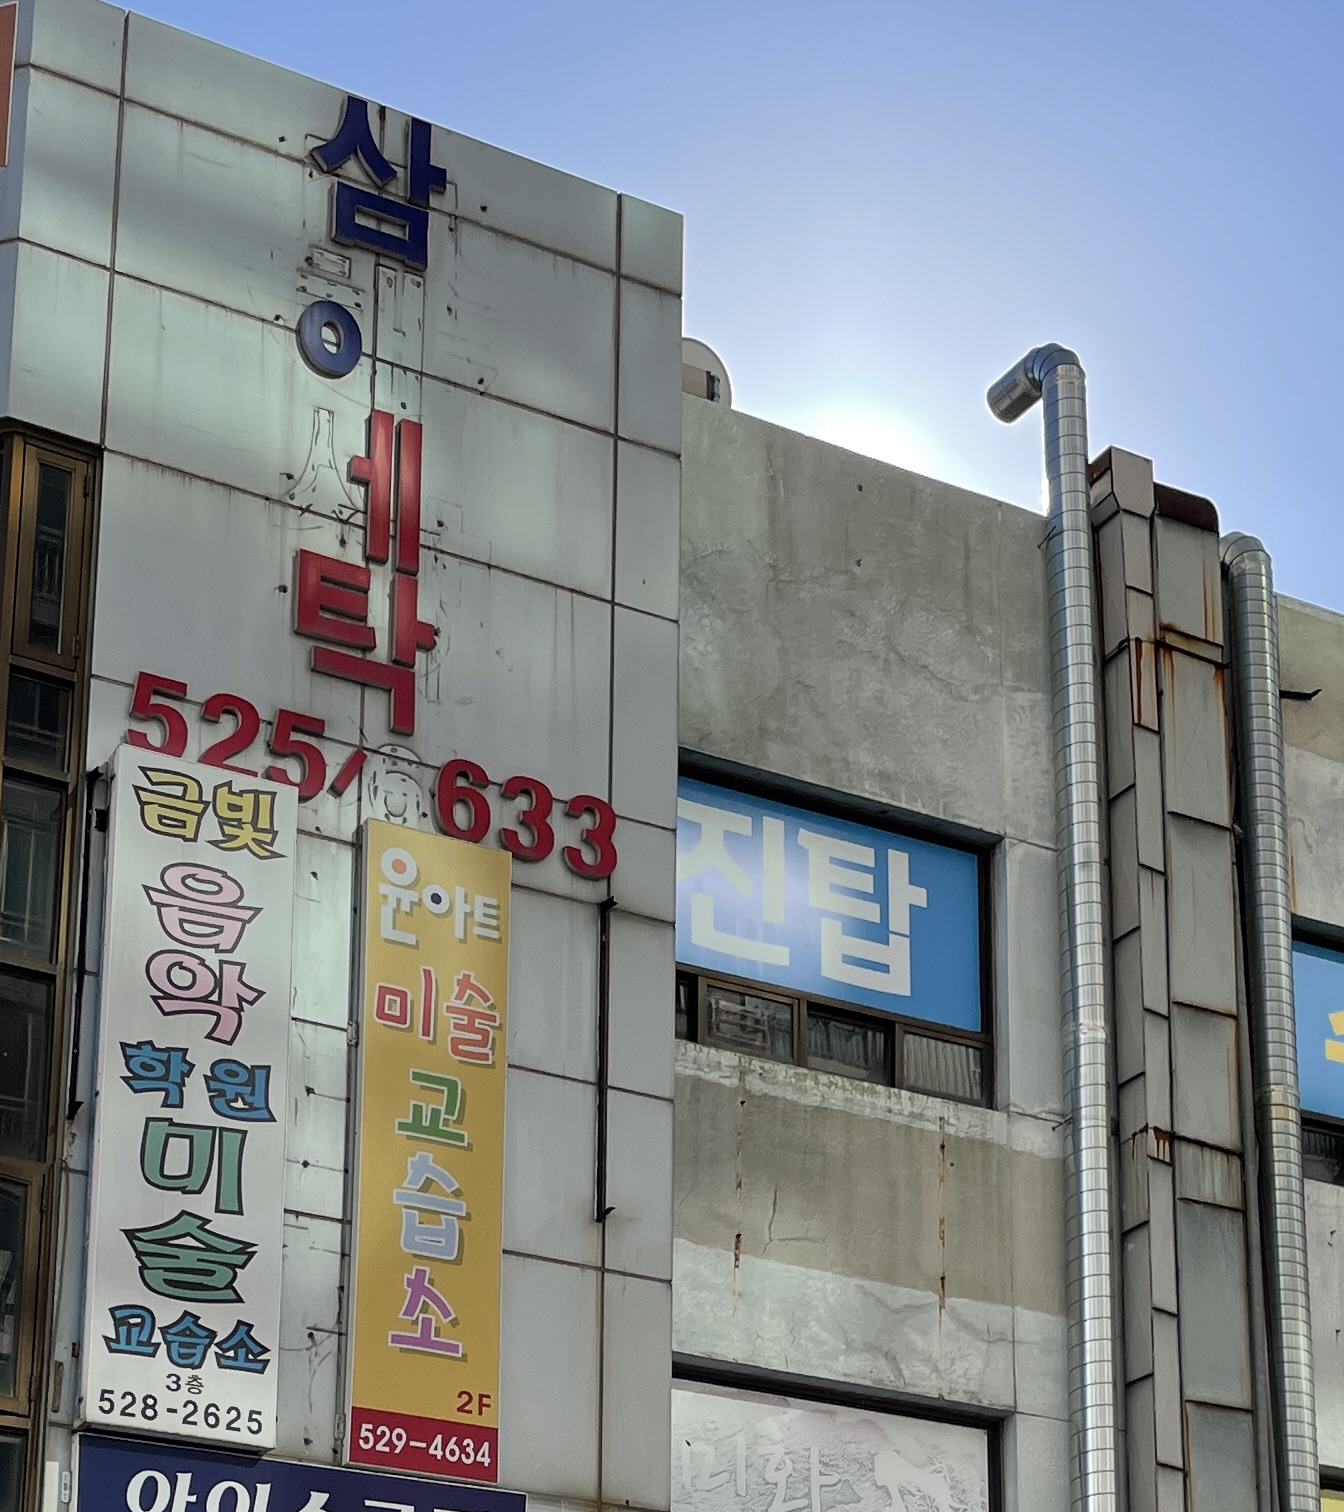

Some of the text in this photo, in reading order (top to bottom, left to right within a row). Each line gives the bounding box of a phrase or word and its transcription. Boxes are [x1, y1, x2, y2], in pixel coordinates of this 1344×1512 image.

[132, 765, 287, 860] 금빛
[378, 847, 502, 947] 윤아트
[143, 862, 266, 1045] 음악
[374, 966, 501, 1067] 미술
[119, 1040, 277, 1123] 학원
[119, 1117, 259, 1304] 미술
[387, 1068, 473, 1358] 교습소
[102, 1304, 272, 1375] 교습소
[165, 1372, 205, 1396] 3층
[97, 1388, 264, 1435] 528-2625
[358, 1423, 492, 1468] 529-4634
[457, 1390, 493, 1418] 2F
